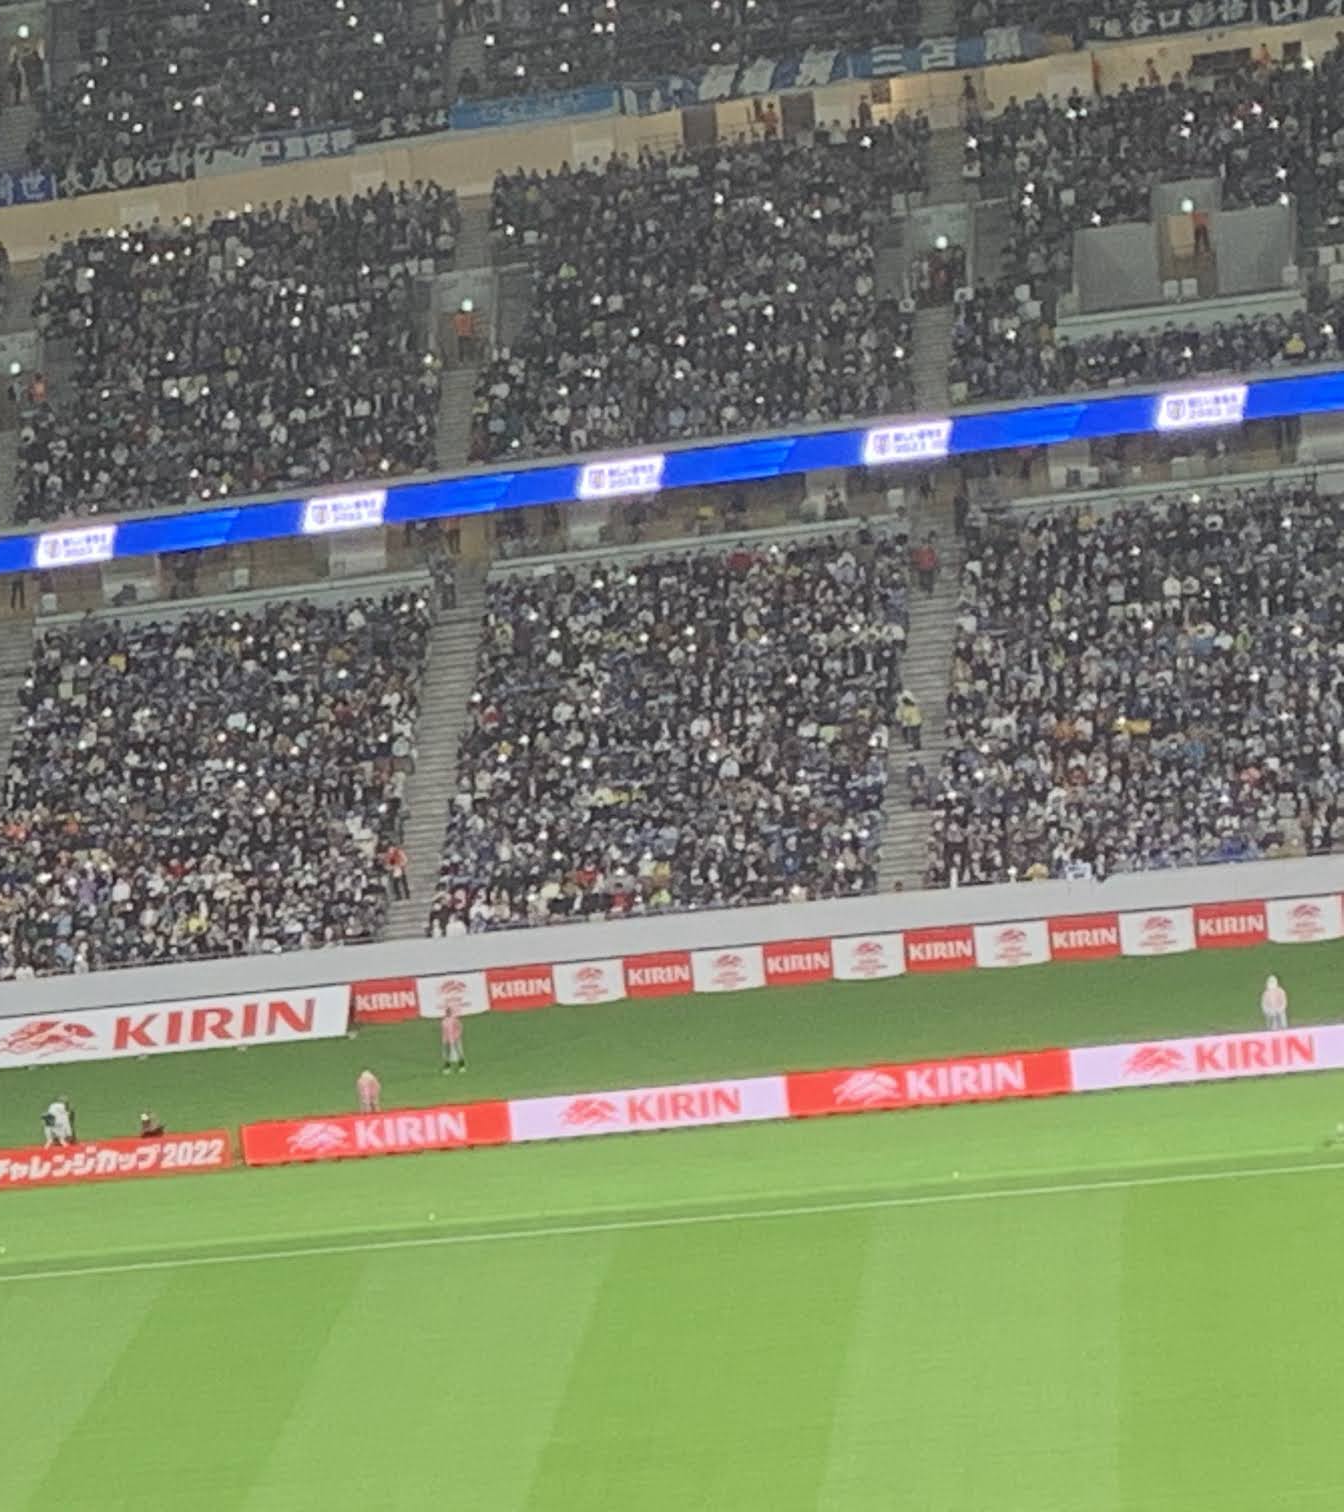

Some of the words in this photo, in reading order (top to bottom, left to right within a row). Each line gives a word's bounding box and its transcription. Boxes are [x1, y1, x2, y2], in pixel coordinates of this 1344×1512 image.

[1052, 926, 1117, 949] KIRIN
[1199, 914, 1265, 938] KIRIN
[910, 938, 973, 961] KIRIN
[766, 951, 830, 974] KIRIN
[628, 964, 690, 986] KIRIN
[490, 977, 551, 1000] KIRIN
[355, 991, 416, 1012] KIRIN
[112, 997, 316, 1050] KIRIN
[1195, 1035, 1316, 1073] KIRIN
[908, 1060, 1025, 1099] KIRIN
[627, 1088, 742, 1123] KIRIN
[356, 1111, 468, 1149] KIRIN
